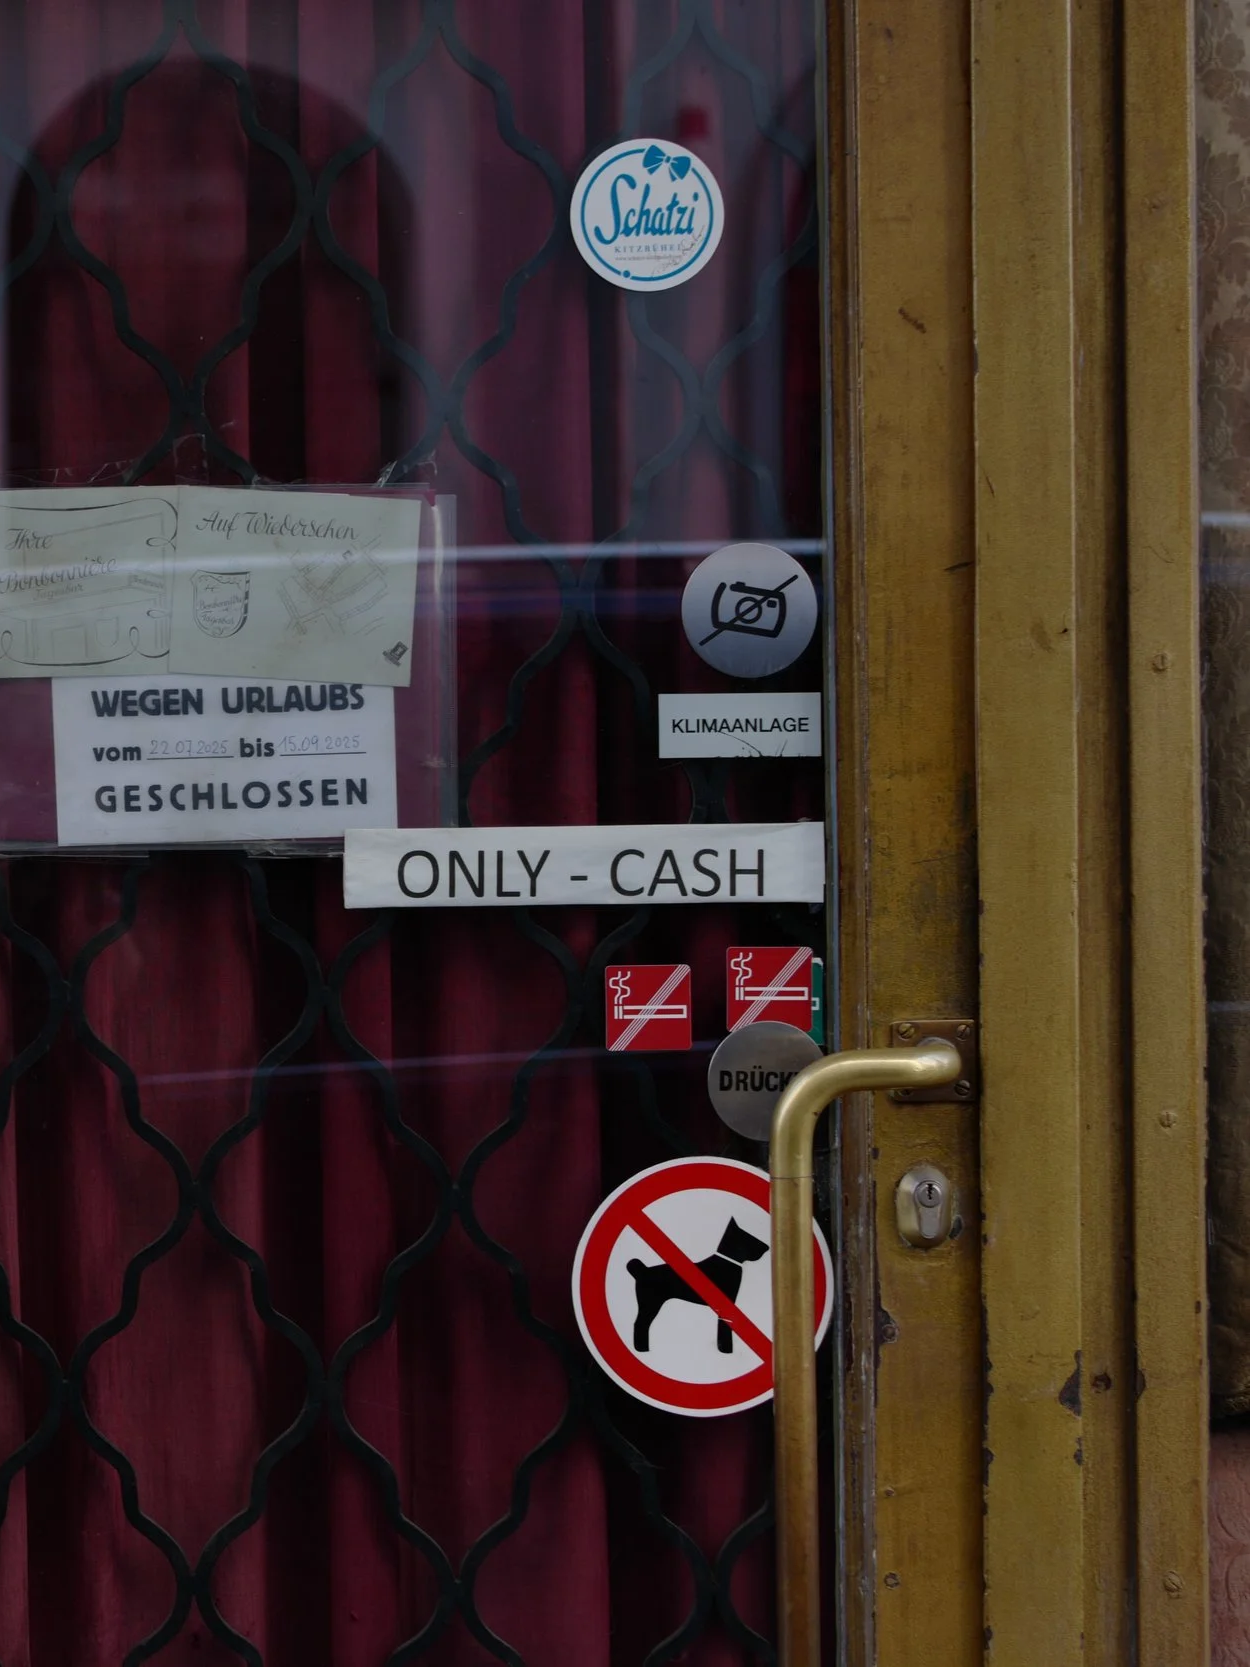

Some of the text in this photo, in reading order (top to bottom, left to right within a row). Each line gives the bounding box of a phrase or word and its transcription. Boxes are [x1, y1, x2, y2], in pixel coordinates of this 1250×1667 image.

[594, 174, 699, 245] Schatzi
[4, 527, 55, 550] Ihre
[195, 510, 361, 540] Auf Wiedersehen
[91, 684, 365, 717] WEGEN URLAUBS
[671, 717, 809, 734] KLIMAANLAGE
[93, 746, 141, 762] vom
[239, 738, 274, 758] bis
[95, 777, 368, 813] GESCHLOSSEN
[397, 848, 765, 899] ONLY - CASH
[719, 1065, 799, 1092] DRÜCK
